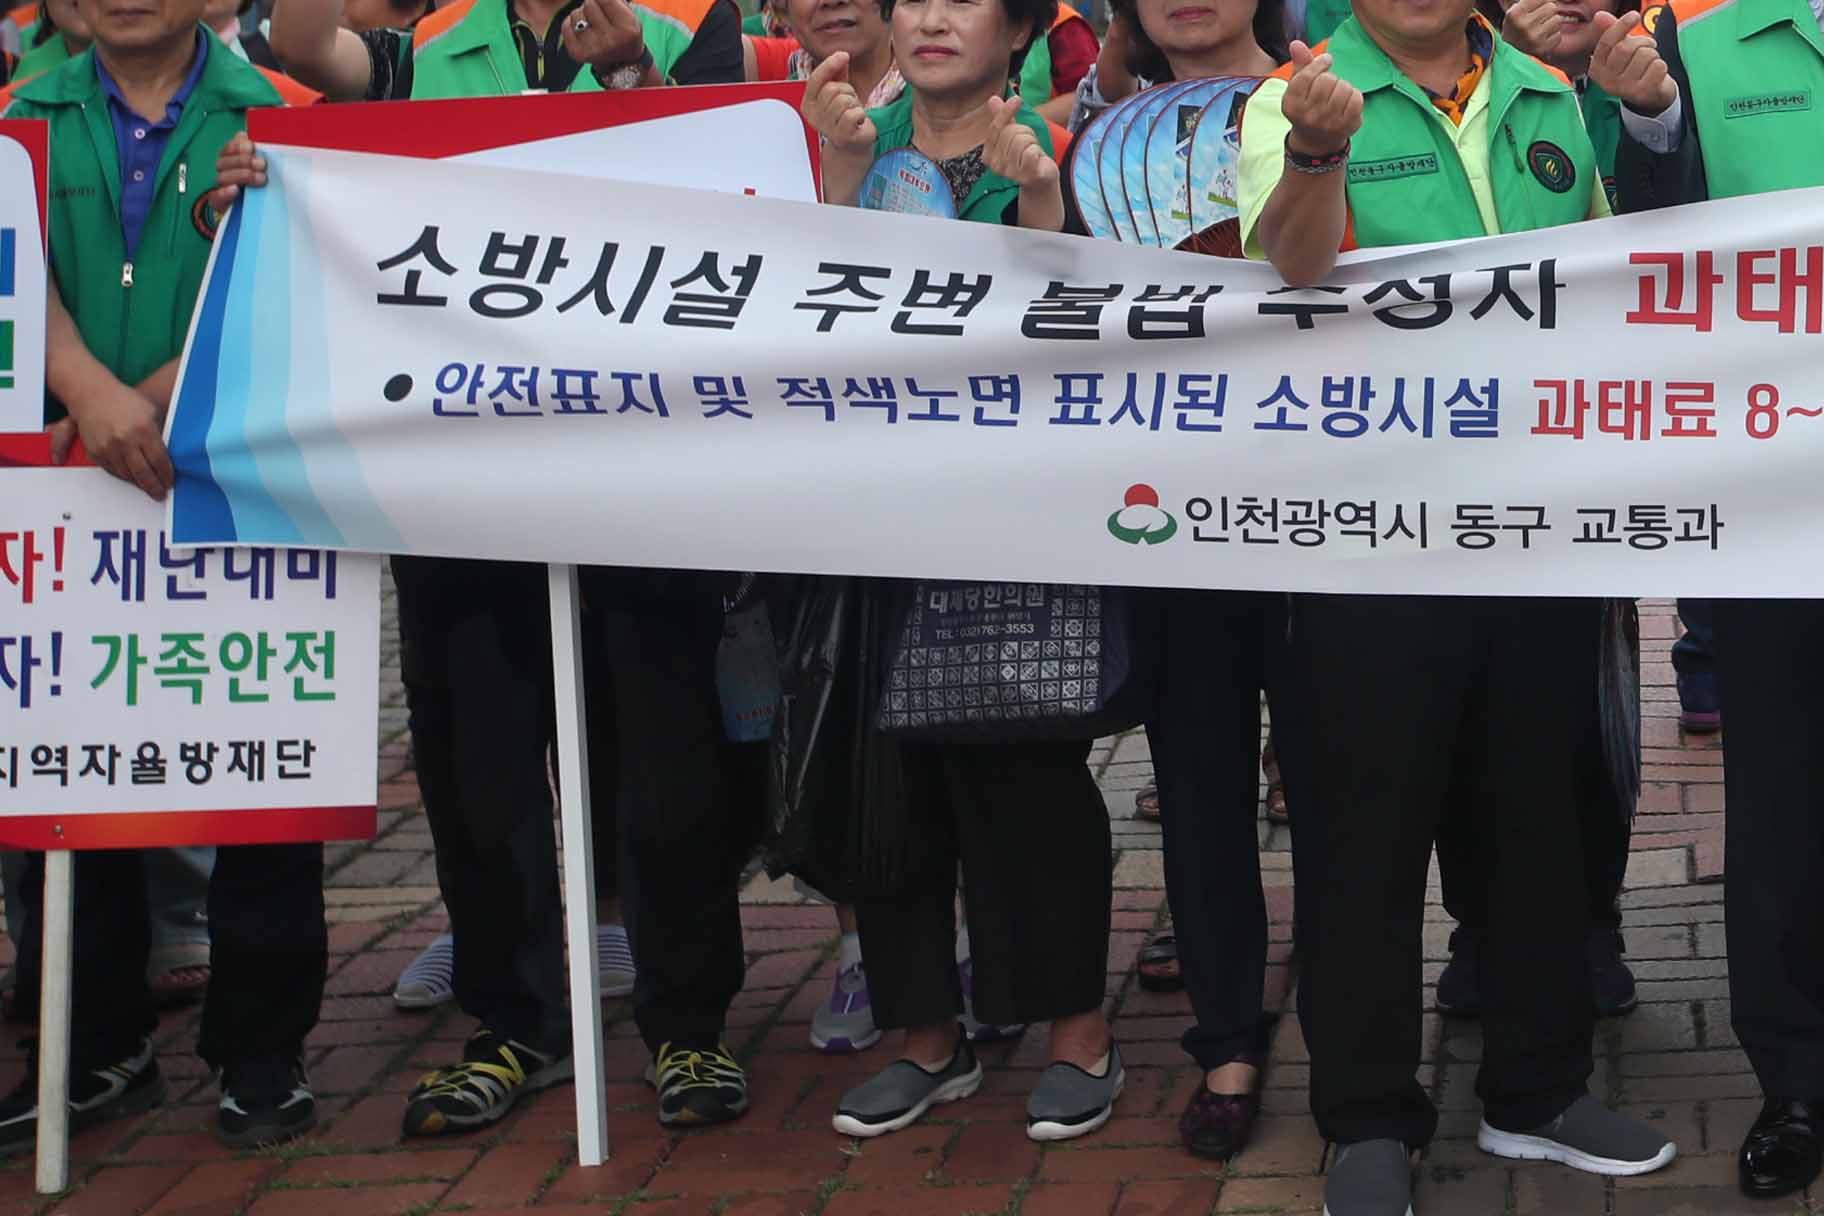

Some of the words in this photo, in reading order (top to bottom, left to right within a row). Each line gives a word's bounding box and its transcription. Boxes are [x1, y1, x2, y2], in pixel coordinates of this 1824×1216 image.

[376, 225, 763, 330] 소방시설
[793, 262, 992, 338] 주변
[1020, 280, 1224, 339] 불법
[431, 362, 669, 419] 안전표지
[693, 376, 753, 419] 및
[776, 374, 1022, 428] 적색노면
[1048, 371, 1228, 433] 표시된
[1254, 375, 1499, 439] 소방시설
[1530, 379, 1717, 440] 과태료
[1184, 495, 1428, 549] 인천광역시
[1450, 504, 1552, 551] 동구
[1572, 504, 1726, 551] 교통과
[90, 630, 337, 707] 가족안전
